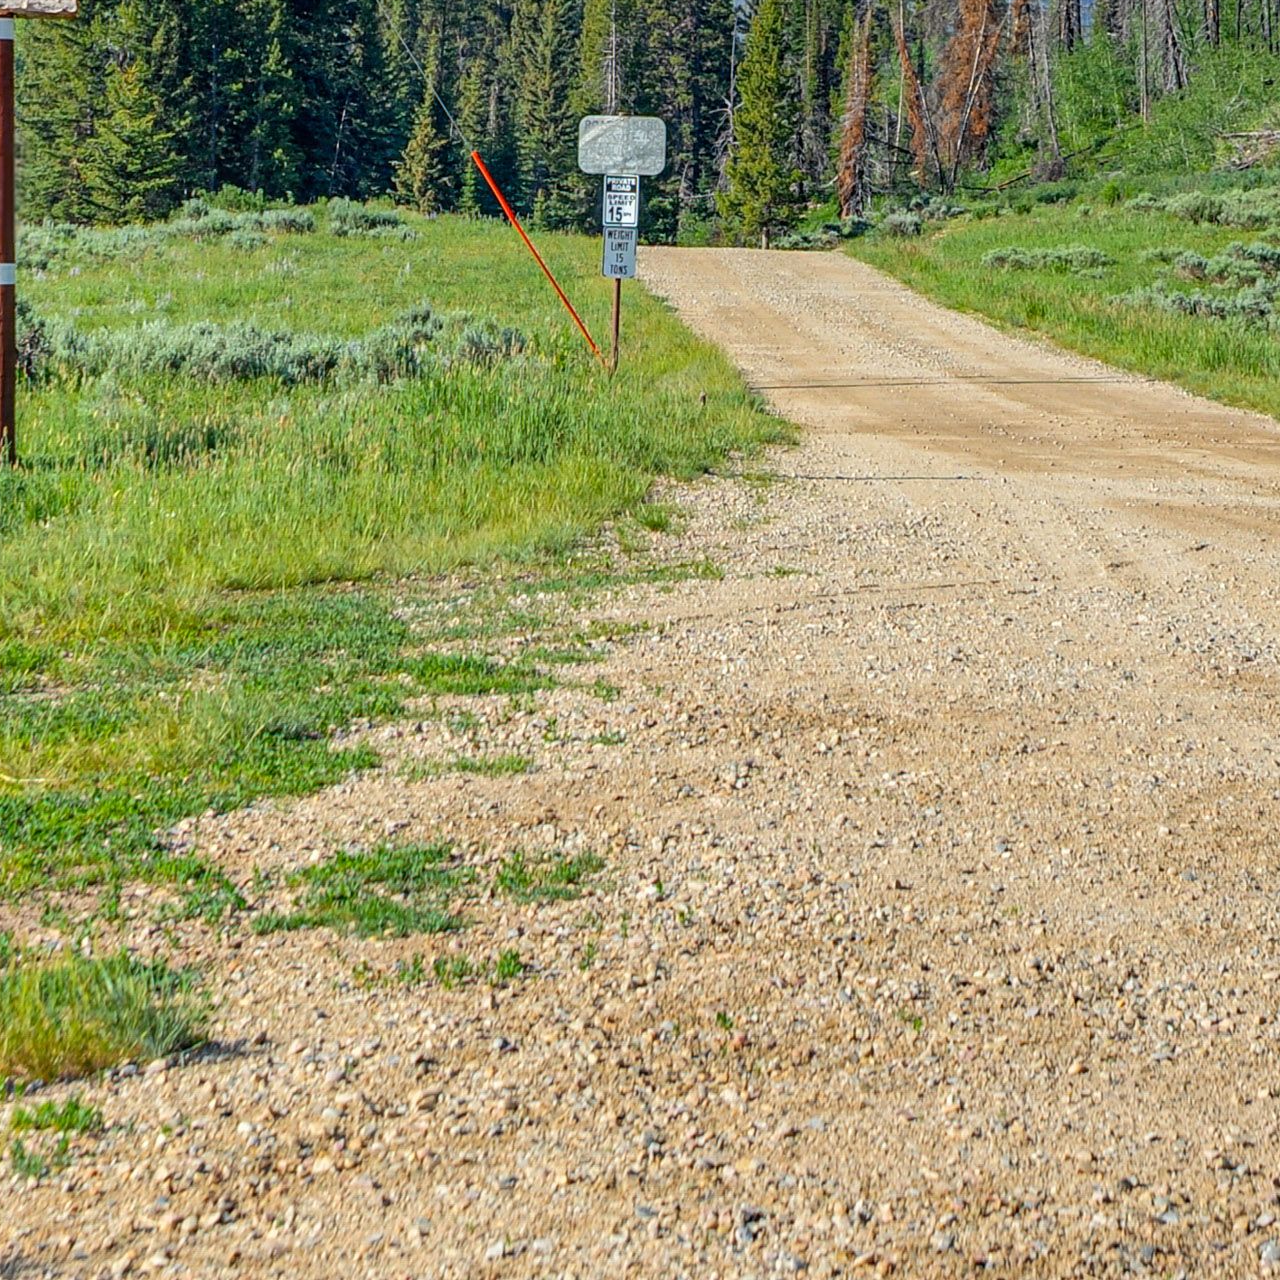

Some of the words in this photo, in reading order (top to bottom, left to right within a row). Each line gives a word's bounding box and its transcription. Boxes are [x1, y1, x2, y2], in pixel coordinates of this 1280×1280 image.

[607, 177, 636, 186] PRIVATE
[608, 206, 623, 222] 15
[607, 230, 634, 241] WEIGHT
[611, 241, 629, 252] LIMIT
[615, 253, 624, 263] 15
[609, 264, 628, 275] TONS
